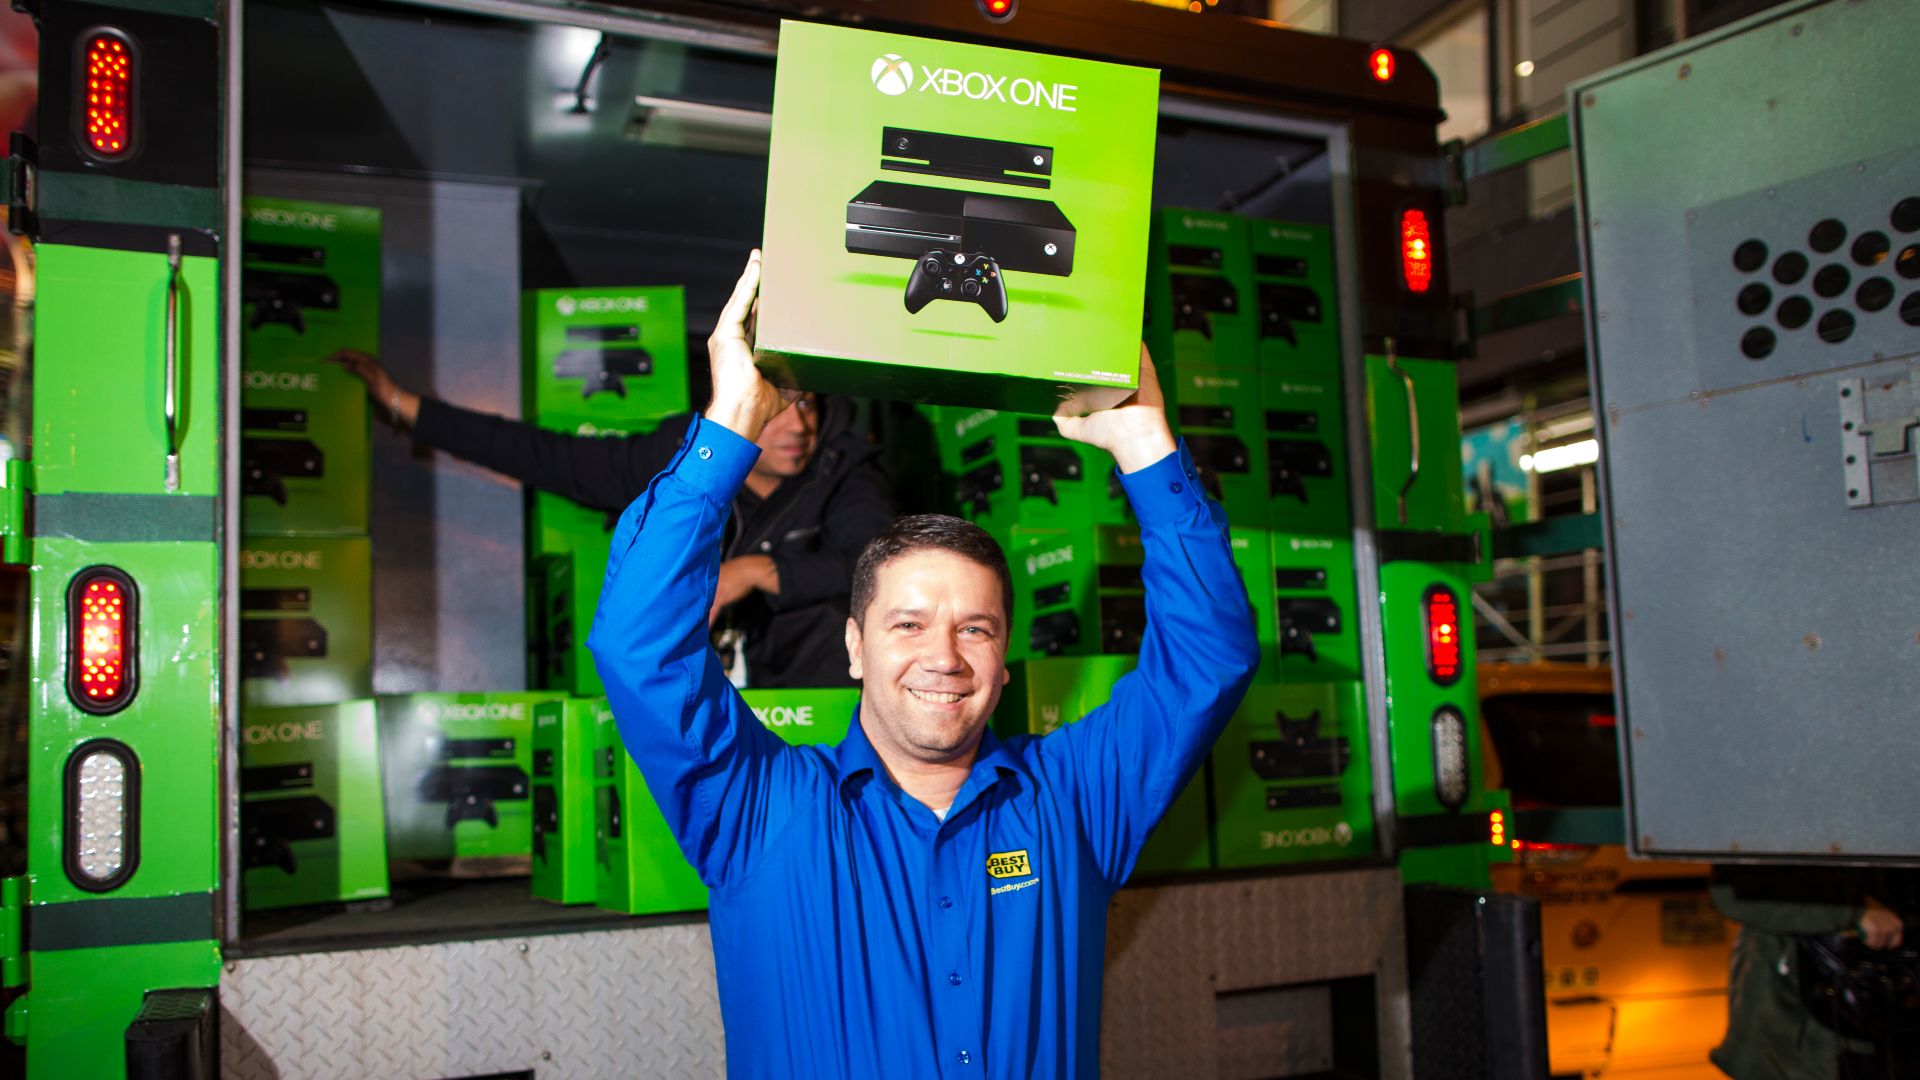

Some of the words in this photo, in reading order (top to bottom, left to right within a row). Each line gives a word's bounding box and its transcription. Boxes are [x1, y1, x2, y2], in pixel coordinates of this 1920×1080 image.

[919, 65, 1007, 103] XBOX
[1010, 78, 1078, 112] ONE
[298, 211, 338, 232] ONE
[277, 372, 321, 392] ONE
[240, 550, 279, 569] BOX
[279, 550, 323, 570] ONE
[488, 703, 526, 720] ONE
[770, 705, 814, 727] ONE
[278, 719, 323, 743] ONE
[991, 854, 1026, 867] BEST
[993, 863, 1025, 876] BUY
